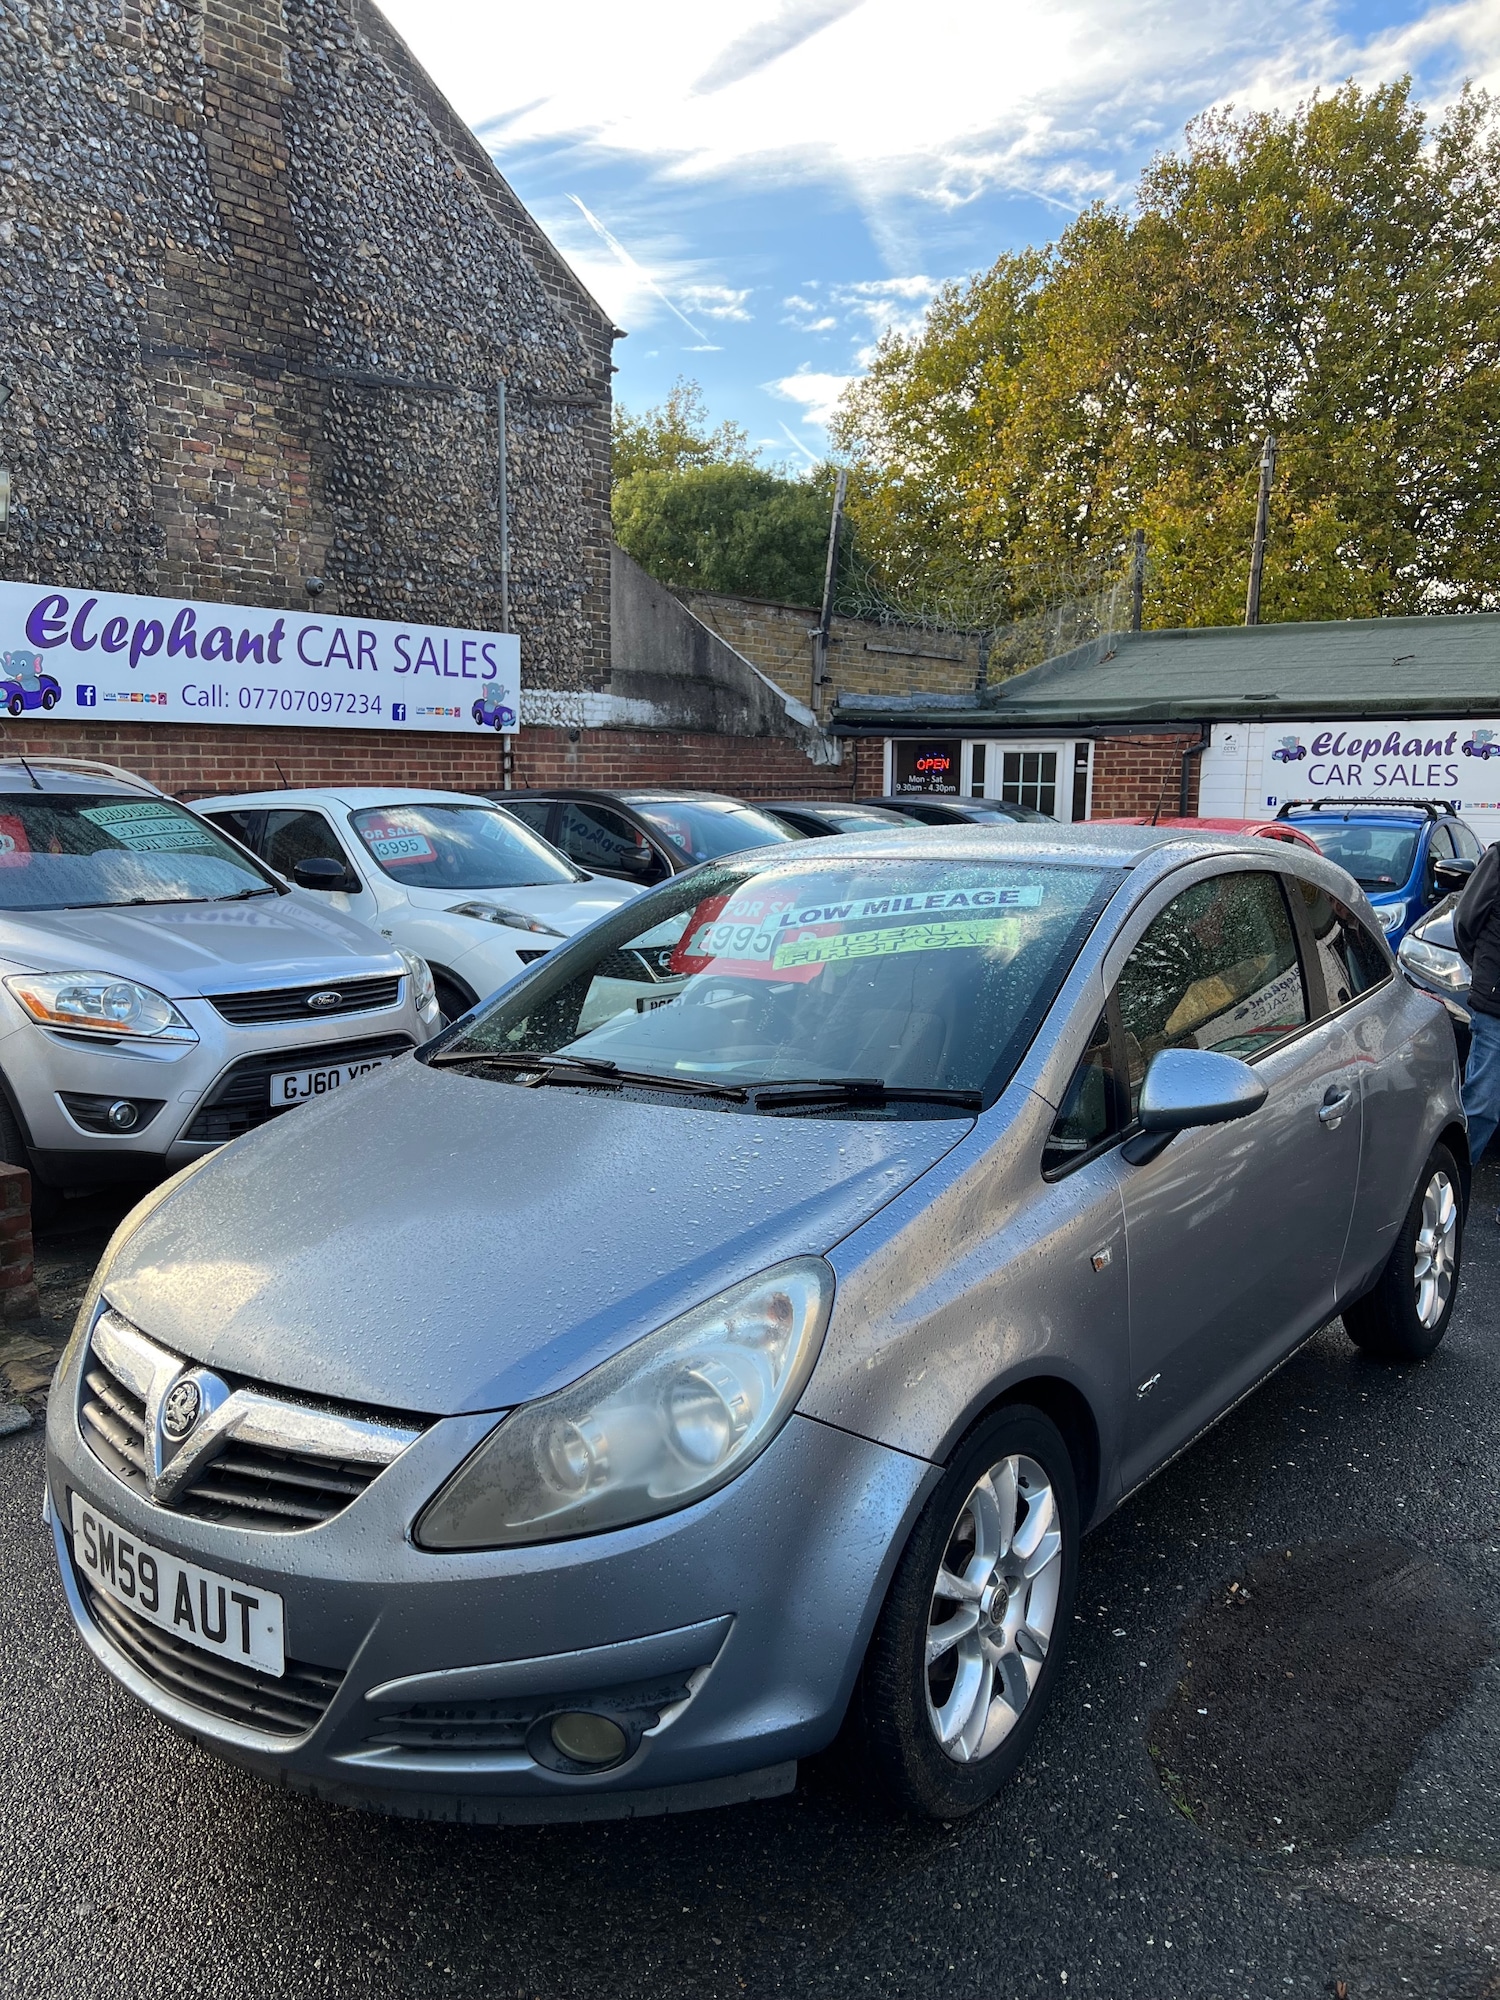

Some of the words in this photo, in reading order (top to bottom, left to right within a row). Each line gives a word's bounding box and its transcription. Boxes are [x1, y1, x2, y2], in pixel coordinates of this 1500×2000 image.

[25, 594, 286, 669] Elephant
[297, 625, 379, 671] CAR
[393, 634, 497, 680] SALES
[182, 684, 229, 708] Call:
[239, 687, 382, 715] 07707097234
[1311, 731, 1457, 762] Elephant
[916, 757, 951, 770] OPEN
[909, 775, 925, 783] Mon
[931, 775, 943, 783] Sat
[1308, 764, 1362, 786] CAR
[1373, 764, 1459, 787] SALES
[896, 783, 922, 791] 9.30am
[928, 783, 956, 793] 4.30pm
[387, 826, 420, 837] SALE
[378, 839, 419, 855] 3995
[722, 900, 763, 917] FOR
[779, 903, 851, 927] LOW
[862, 890, 1019, 914] MILEAGE
[833, 924, 958, 946] IDEAL
[783, 939, 903, 966] FIRST
[915, 931, 1008, 948] CAR
[317, 995, 336, 1005] Ford
[284, 1070, 340, 1099] GJ60
[83, 1512, 159, 1612] SM59
[173, 1571, 259, 1654] AUT
